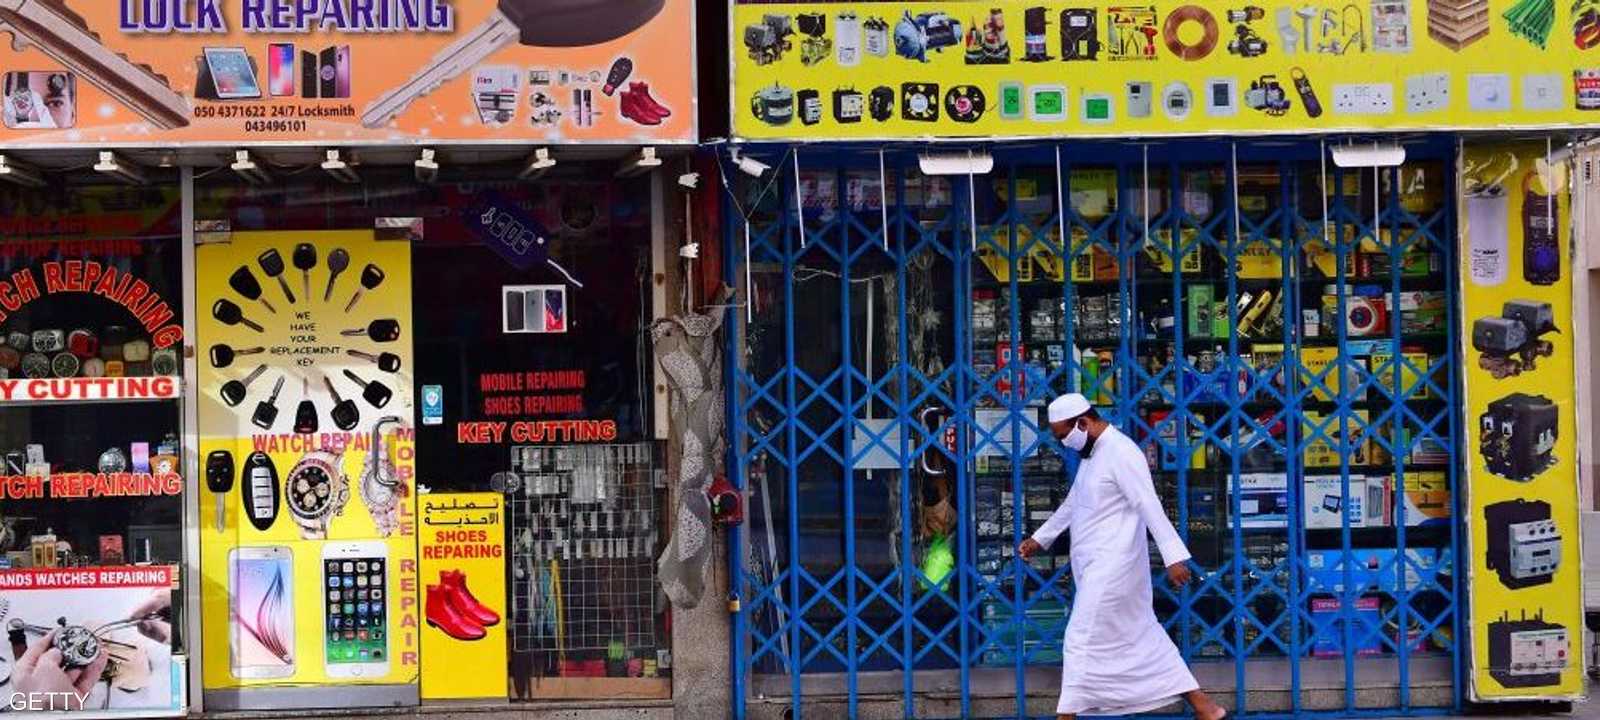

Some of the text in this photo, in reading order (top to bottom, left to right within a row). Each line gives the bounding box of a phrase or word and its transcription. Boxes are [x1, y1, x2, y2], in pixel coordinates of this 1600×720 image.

[119, 0, 455, 33] LOCK REPARING
[194, 104, 355, 118] 050 4371622 24/7 Locksmith
[245, 120, 306, 132] 043496101
[43, 260, 184, 350] REPAIRING
[290, 323, 316, 331] HAVE
[270, 346, 341, 355] REPLACEMENT
[297, 357, 314, 366] KEY
[28, 378, 173, 398] CUTTING
[480, 370, 585, 391] MOBILE REPAIRING
[484, 394, 583, 415] SHOES REPAIRING
[458, 420, 616, 443] KEY CUTTING
[252, 434, 314, 453] WATCH
[50, 472, 182, 498] REPAIRING
[436, 530, 487, 543] SHOES
[423, 545, 502, 560] REPARING
[36, 572, 96, 585] WATCHES
[400, 559, 417, 664] REPAIR
